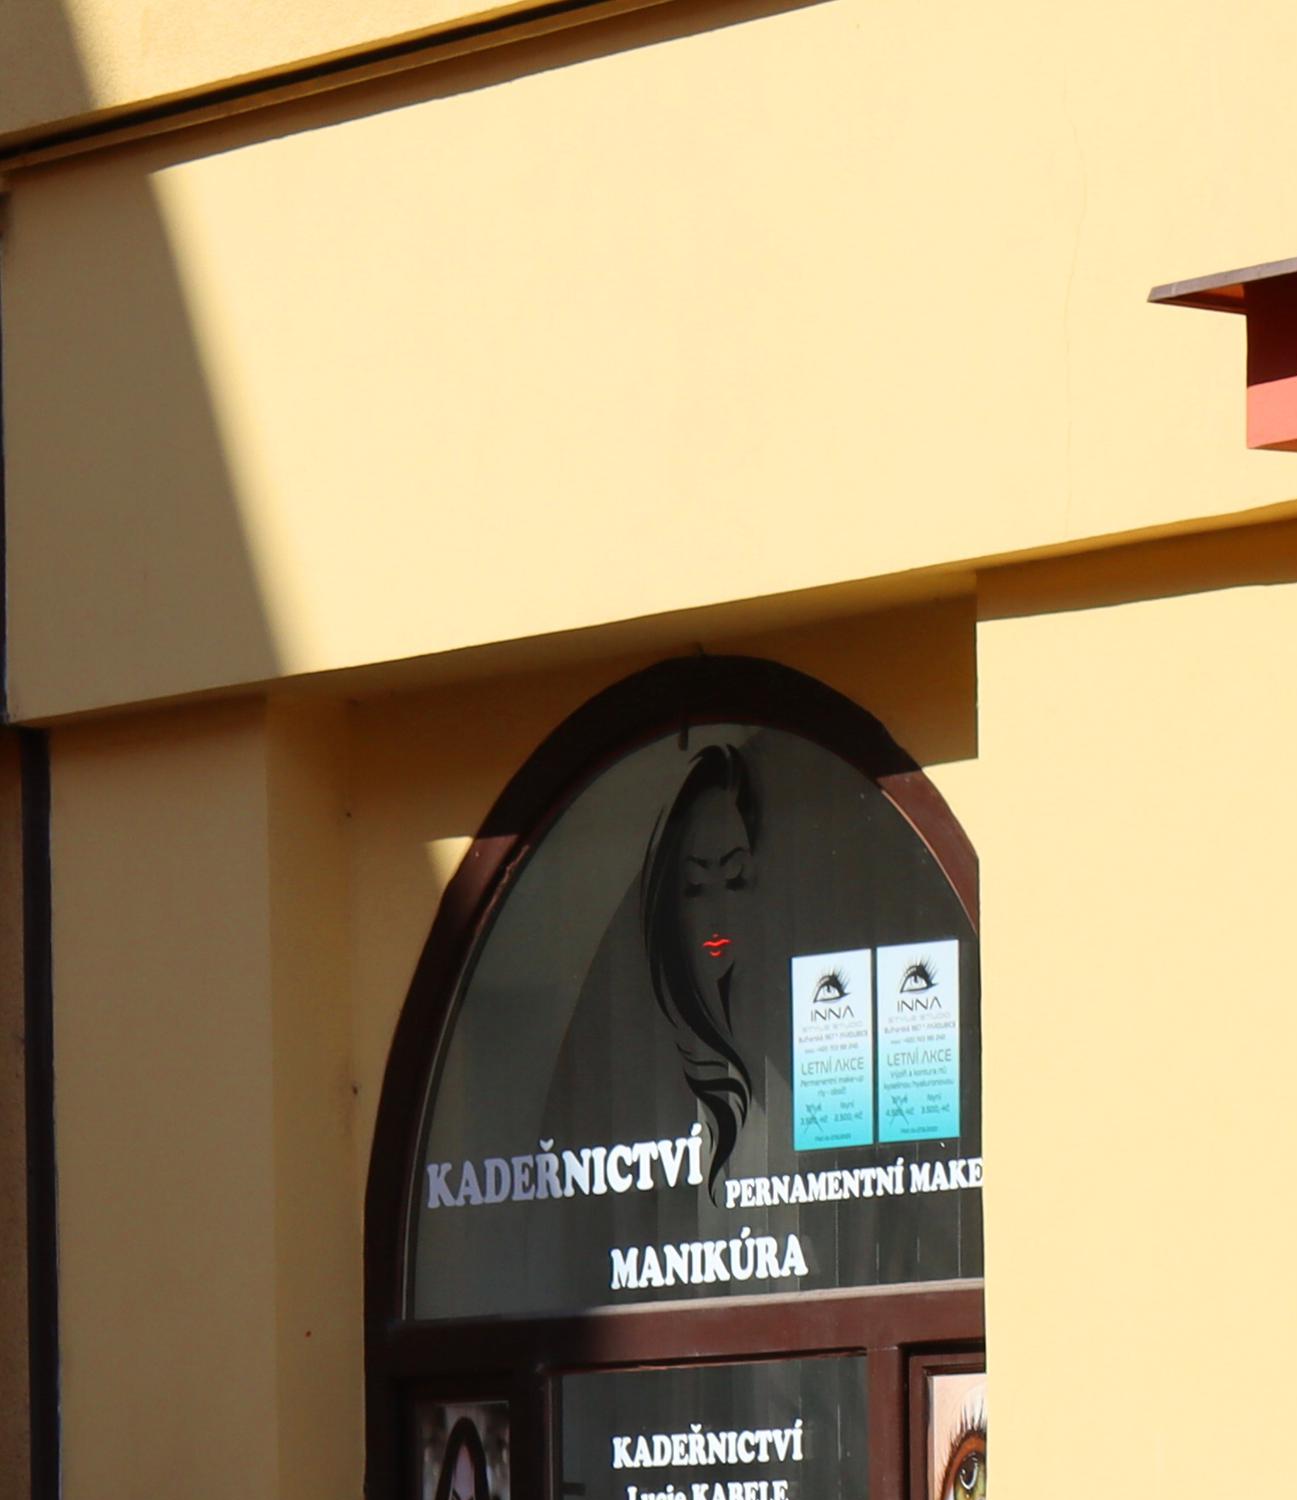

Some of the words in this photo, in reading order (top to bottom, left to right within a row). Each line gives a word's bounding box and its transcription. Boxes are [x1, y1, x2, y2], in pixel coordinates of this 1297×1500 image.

[810, 1005, 855, 1022] INNA
[896, 996, 942, 1013] INNA
[801, 1056, 832, 1076] LETNÍ
[834, 1057, 865, 1072] AKCE
[886, 1048, 919, 1066] LETNÍ
[921, 1048, 952, 1063] AKCE
[427, 1122, 703, 1208] KADEŘNICTVÍ
[725, 1157, 905, 1209] PERNAMENTNÍ
[910, 1157, 983, 1195] MAKE
[610, 1227, 808, 1289] MANIKÚRA
[612, 1419, 803, 1468] KADEŘNICTVÍ
